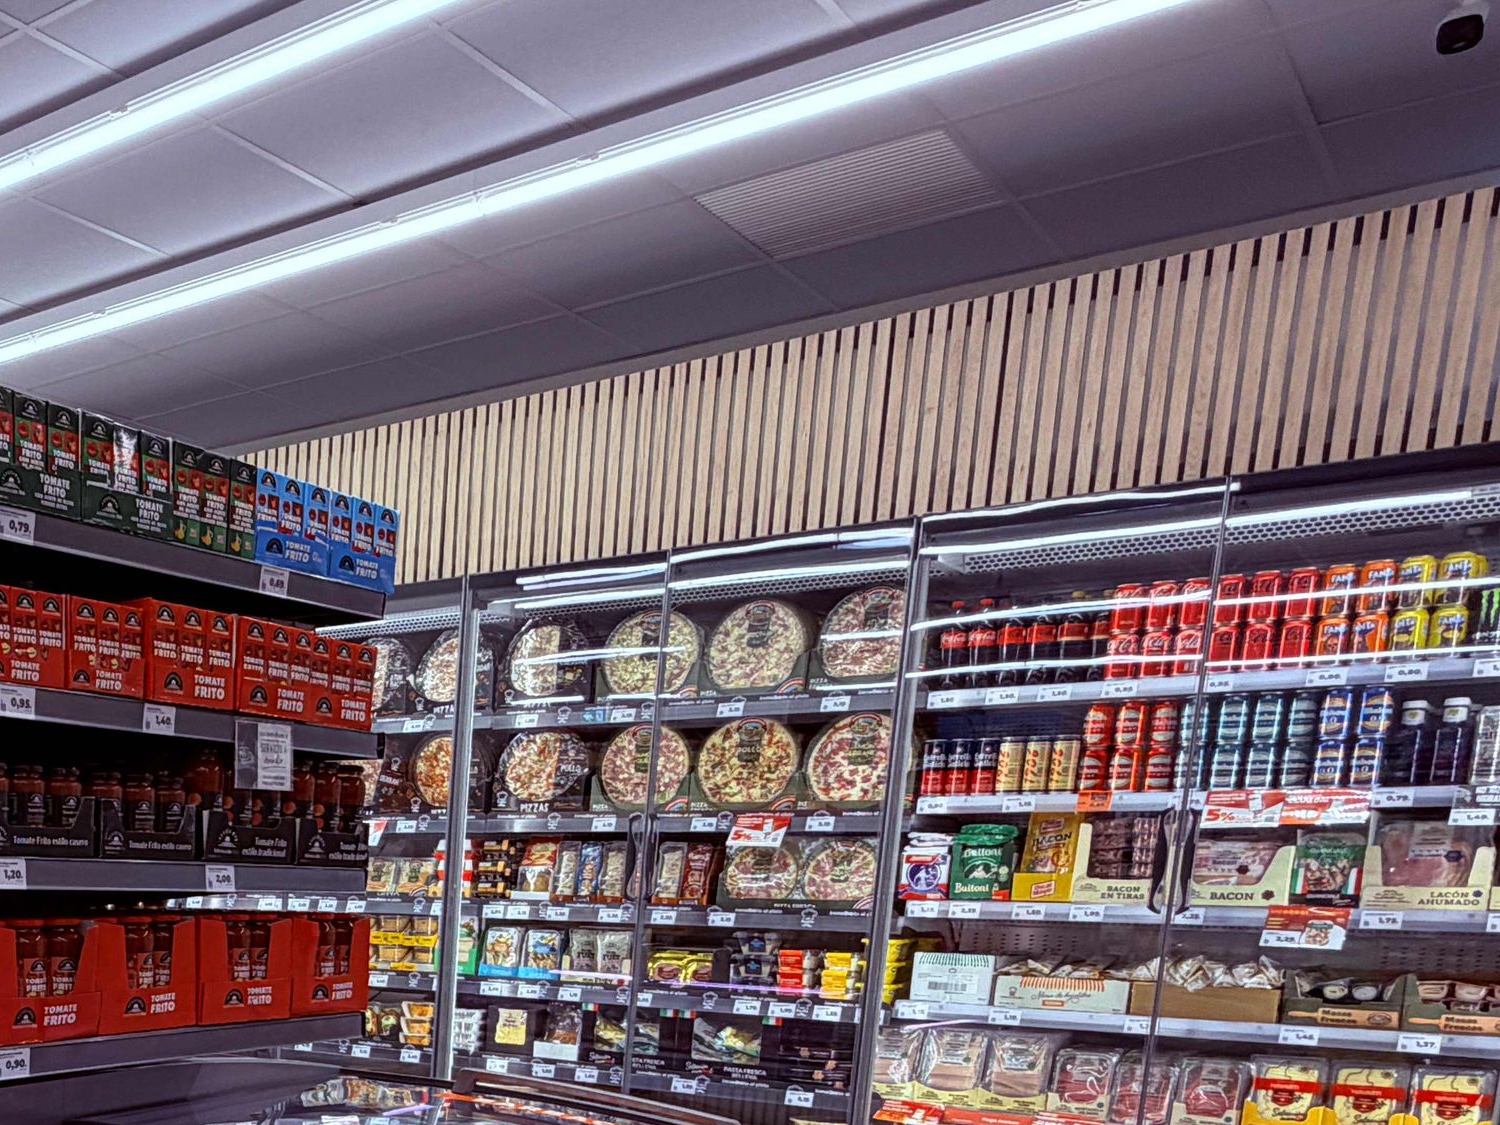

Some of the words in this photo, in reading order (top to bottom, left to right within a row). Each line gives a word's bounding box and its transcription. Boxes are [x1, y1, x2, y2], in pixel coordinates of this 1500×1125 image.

[54, 457, 76, 470] FRITO
[39, 472, 71, 490] TOMATE
[43, 485, 67, 498] FRITO
[135, 498, 164, 514] TOMATE
[139, 508, 160, 521] FRITO
[285, 541, 311, 553] TOMATE
[285, 549, 310, 563] FRITO
[356, 558, 379, 570] TOMATE
[355, 566, 378, 579] FRITO
[13, 633, 37, 646] FRITO
[39, 636, 62, 648] FRITO
[73, 641, 97, 653] FRITO
[99, 645, 120, 657] FRITO
[154, 647, 177, 660] FRITO
[181, 652, 204, 665] FRITO
[10, 660, 41, 671] TOMATE
[208, 656, 231, 668] FRITO
[10, 669, 40, 682] FRITO
[95, 669, 123, 681] TOMATE
[268, 667, 288, 679] FRITO
[95, 678, 122, 691] FRITO
[194, 674, 226, 687] TOMATE
[194, 685, 225, 700] FRITO
[277, 687, 304, 700] TOMATE
[276, 699, 304, 713] FRITO
[341, 699, 367, 711] TOMATE
[340, 708, 366, 722] FRITO
[520, 802, 549, 813] PIZZAS
[13, 835, 35, 846] Tomate
[36, 835, 51, 847] Frito
[51, 835, 69, 846] estilo
[69, 837, 89, 847] casero
[954, 882, 990, 894] Buitoni
[1106, 884, 1141, 894] BACON
[1430, 889, 1469, 899] LACÓN
[1101, 891, 1115, 900] EN
[1116, 891, 1145, 901] TIRAS
[1210, 892, 1255, 901] BACON
[1417, 898, 1480, 906] AHUMADO
[150, 992, 176, 1003] TOMATE
[247, 994, 273, 1006] FRITO
[331, 988, 353, 1000] FRITO
[43, 1003, 78, 1015] TOMATE
[150, 1001, 176, 1014] FRITO
[43, 1013, 77, 1027] FRITO
